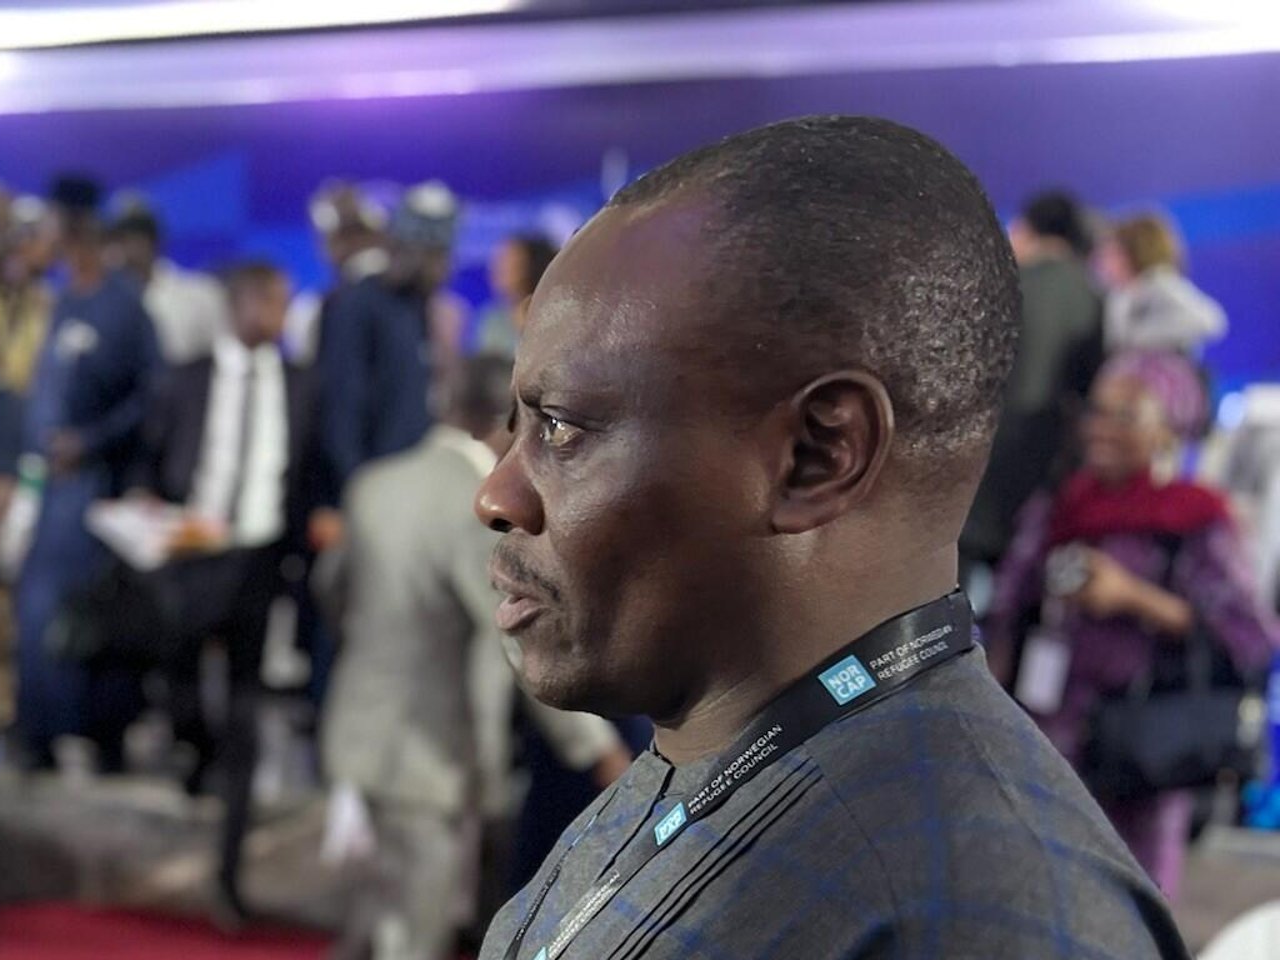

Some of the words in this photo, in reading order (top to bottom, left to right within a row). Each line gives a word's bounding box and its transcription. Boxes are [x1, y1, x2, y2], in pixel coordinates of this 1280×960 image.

[869, 651, 896, 670] PART
[895, 643, 910, 657] OF
[828, 664, 861, 688] NOR
[836, 674, 866, 698] CAP
[688, 786, 710, 808] PART
[710, 774, 723, 789] OF
[723, 724, 782, 777] NORWEGIAN
[733, 742, 778, 779] COUNCIL
